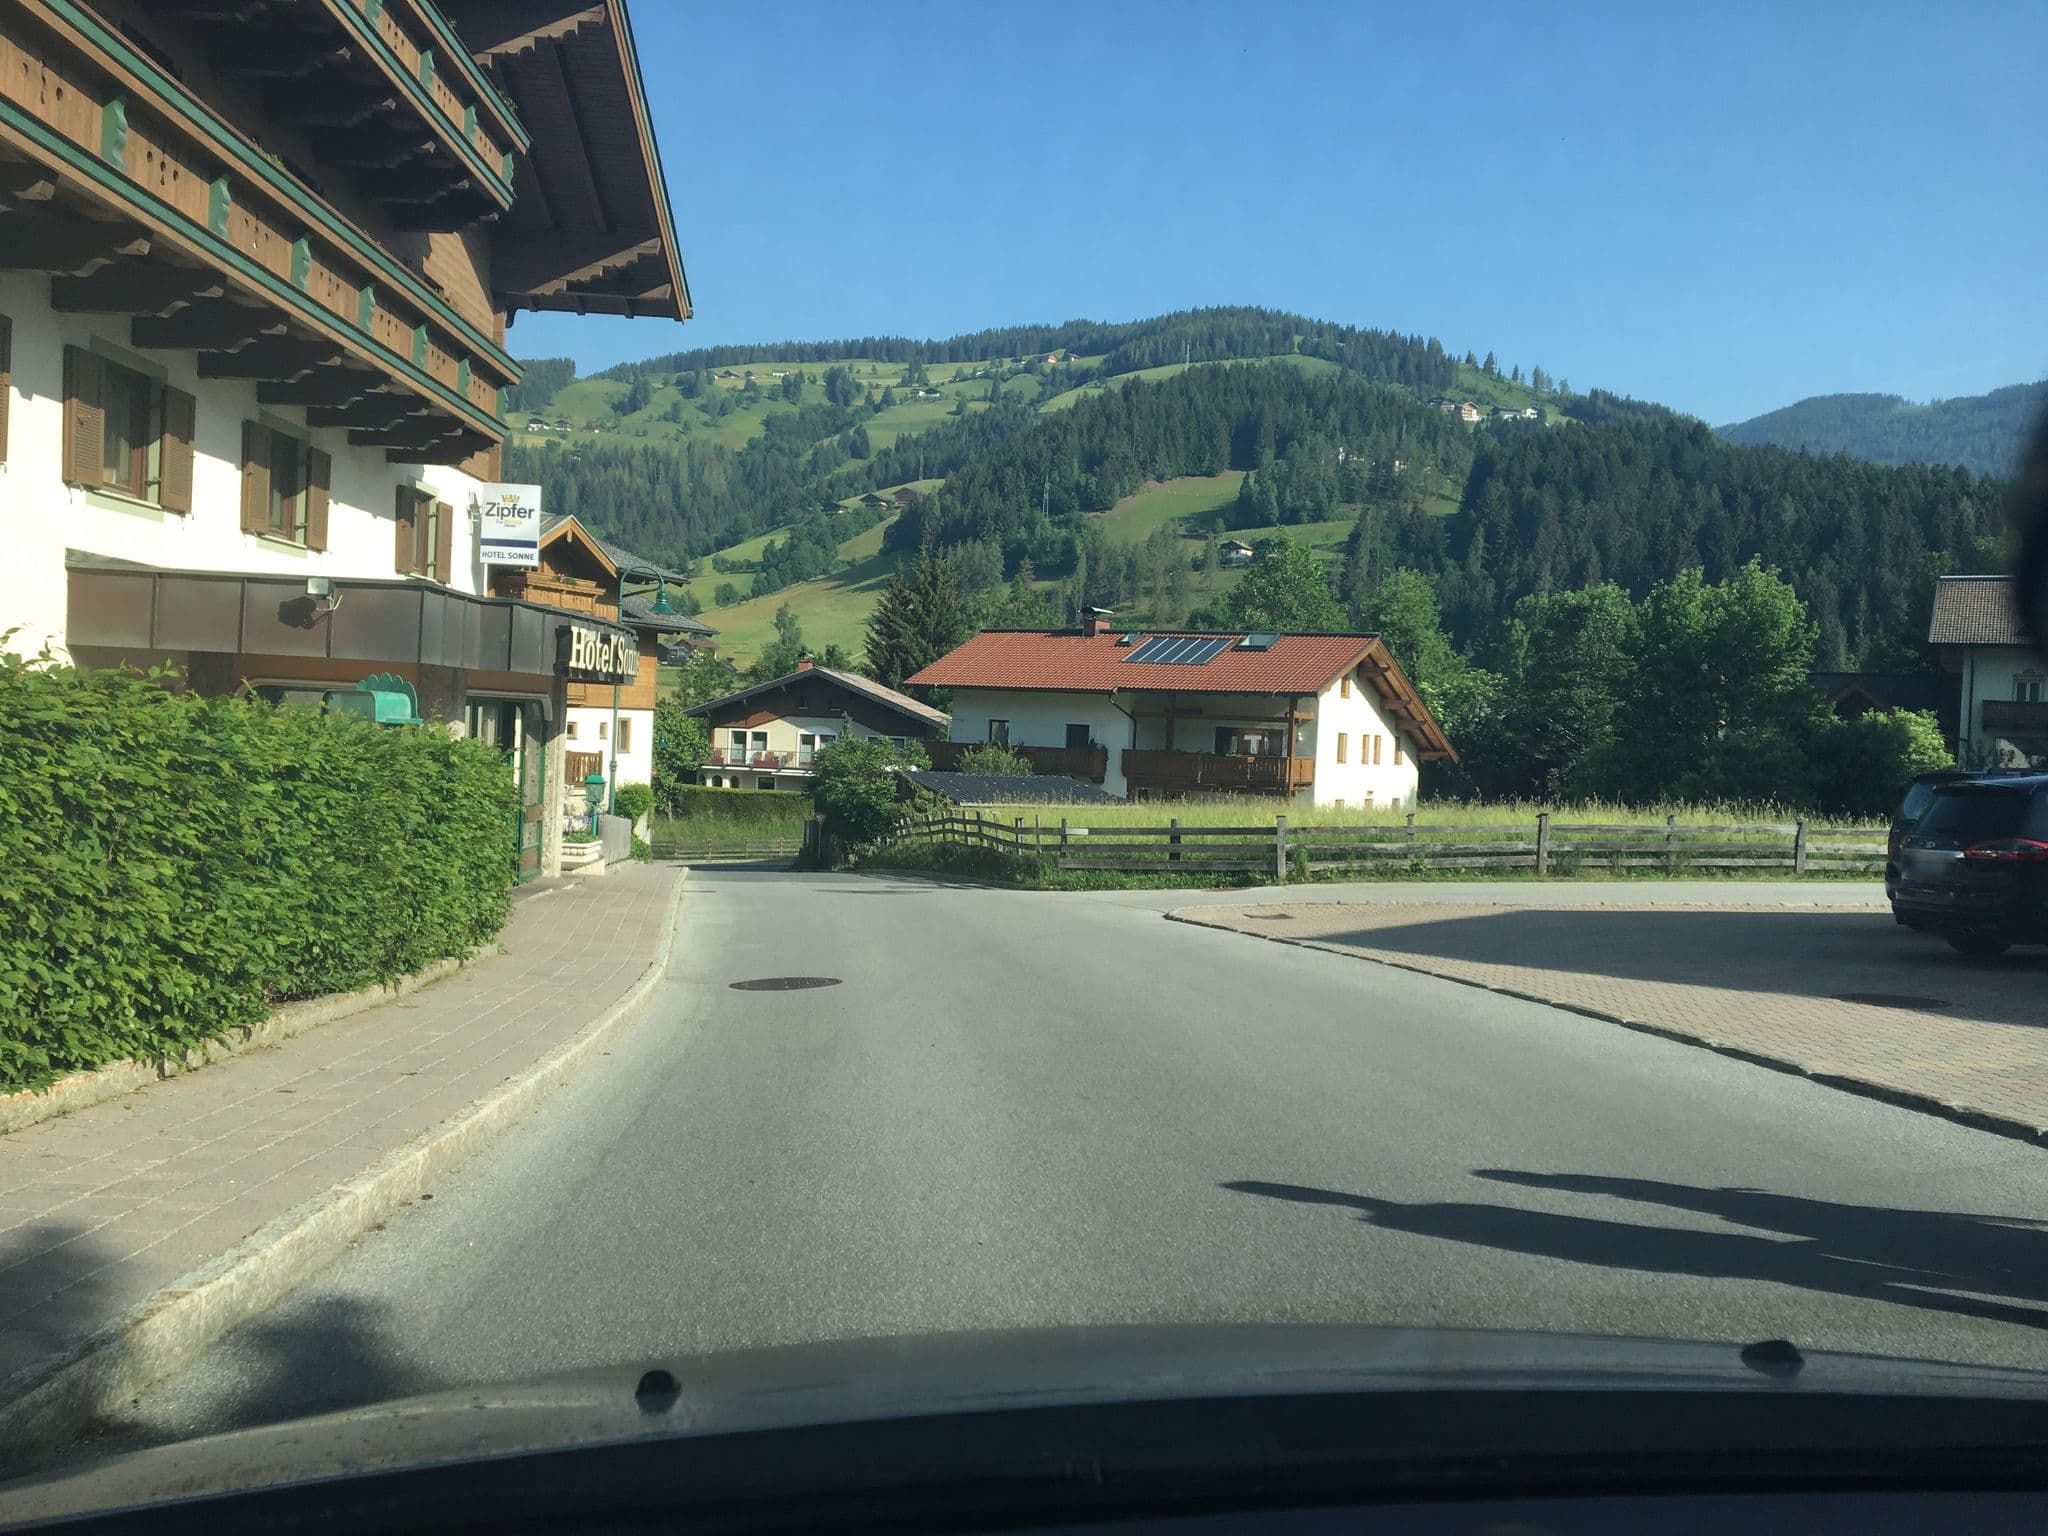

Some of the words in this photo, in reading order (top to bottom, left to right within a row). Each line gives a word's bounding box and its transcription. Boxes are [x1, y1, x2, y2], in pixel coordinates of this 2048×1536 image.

[485, 502, 535, 520] Zipfer
[481, 551, 506, 559] HOTEL
[507, 551, 535, 560] SONNE
[569, 626, 614, 673] Hotel
